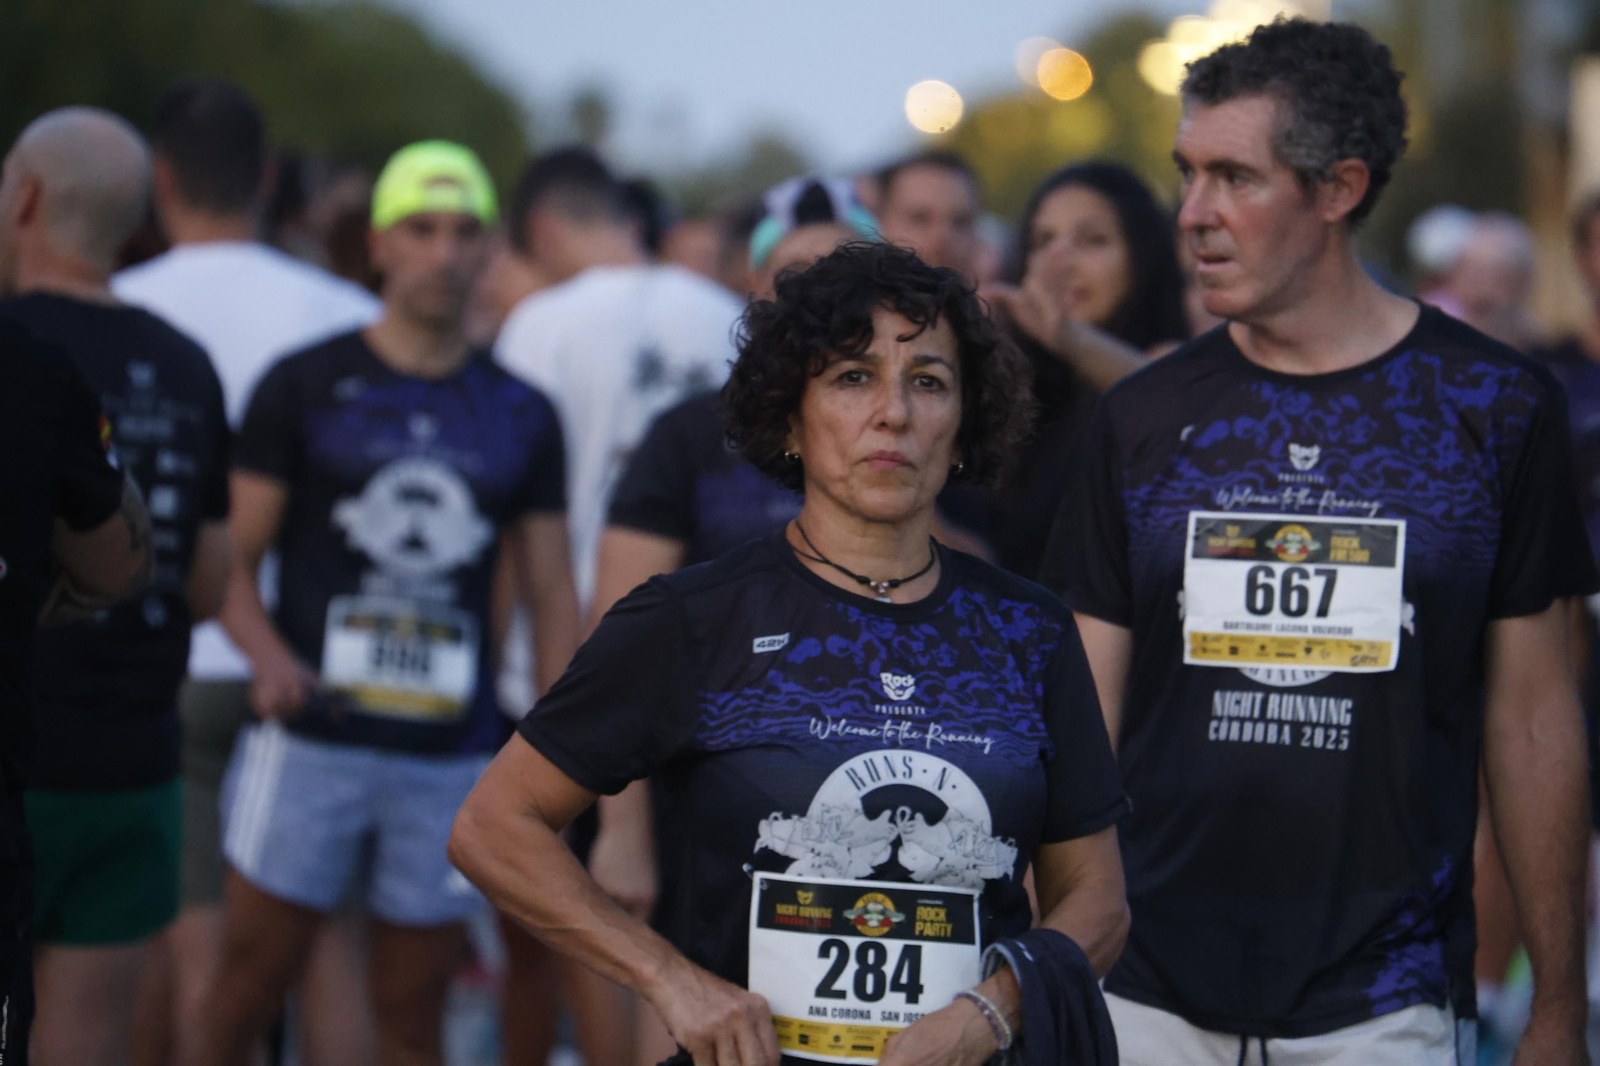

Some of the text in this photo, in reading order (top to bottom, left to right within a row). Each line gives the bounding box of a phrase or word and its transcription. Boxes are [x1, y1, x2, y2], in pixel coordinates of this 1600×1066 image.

[1245, 565, 1338, 618] 667
[874, 704, 926, 716] PRESENTS
[1211, 690, 1353, 727] NIGHT RUNNING
[809, 715, 879, 740] Welcome
[898, 720, 922, 745] the
[924, 722, 995, 754] Running
[1300, 726, 1350, 751] 2025
[916, 906, 946, 922] ROCK
[915, 921, 952, 939] PARTY
[814, 938, 924, 1005] 284
[808, 1005, 924, 1024] ANA CORONA SAN JOS
